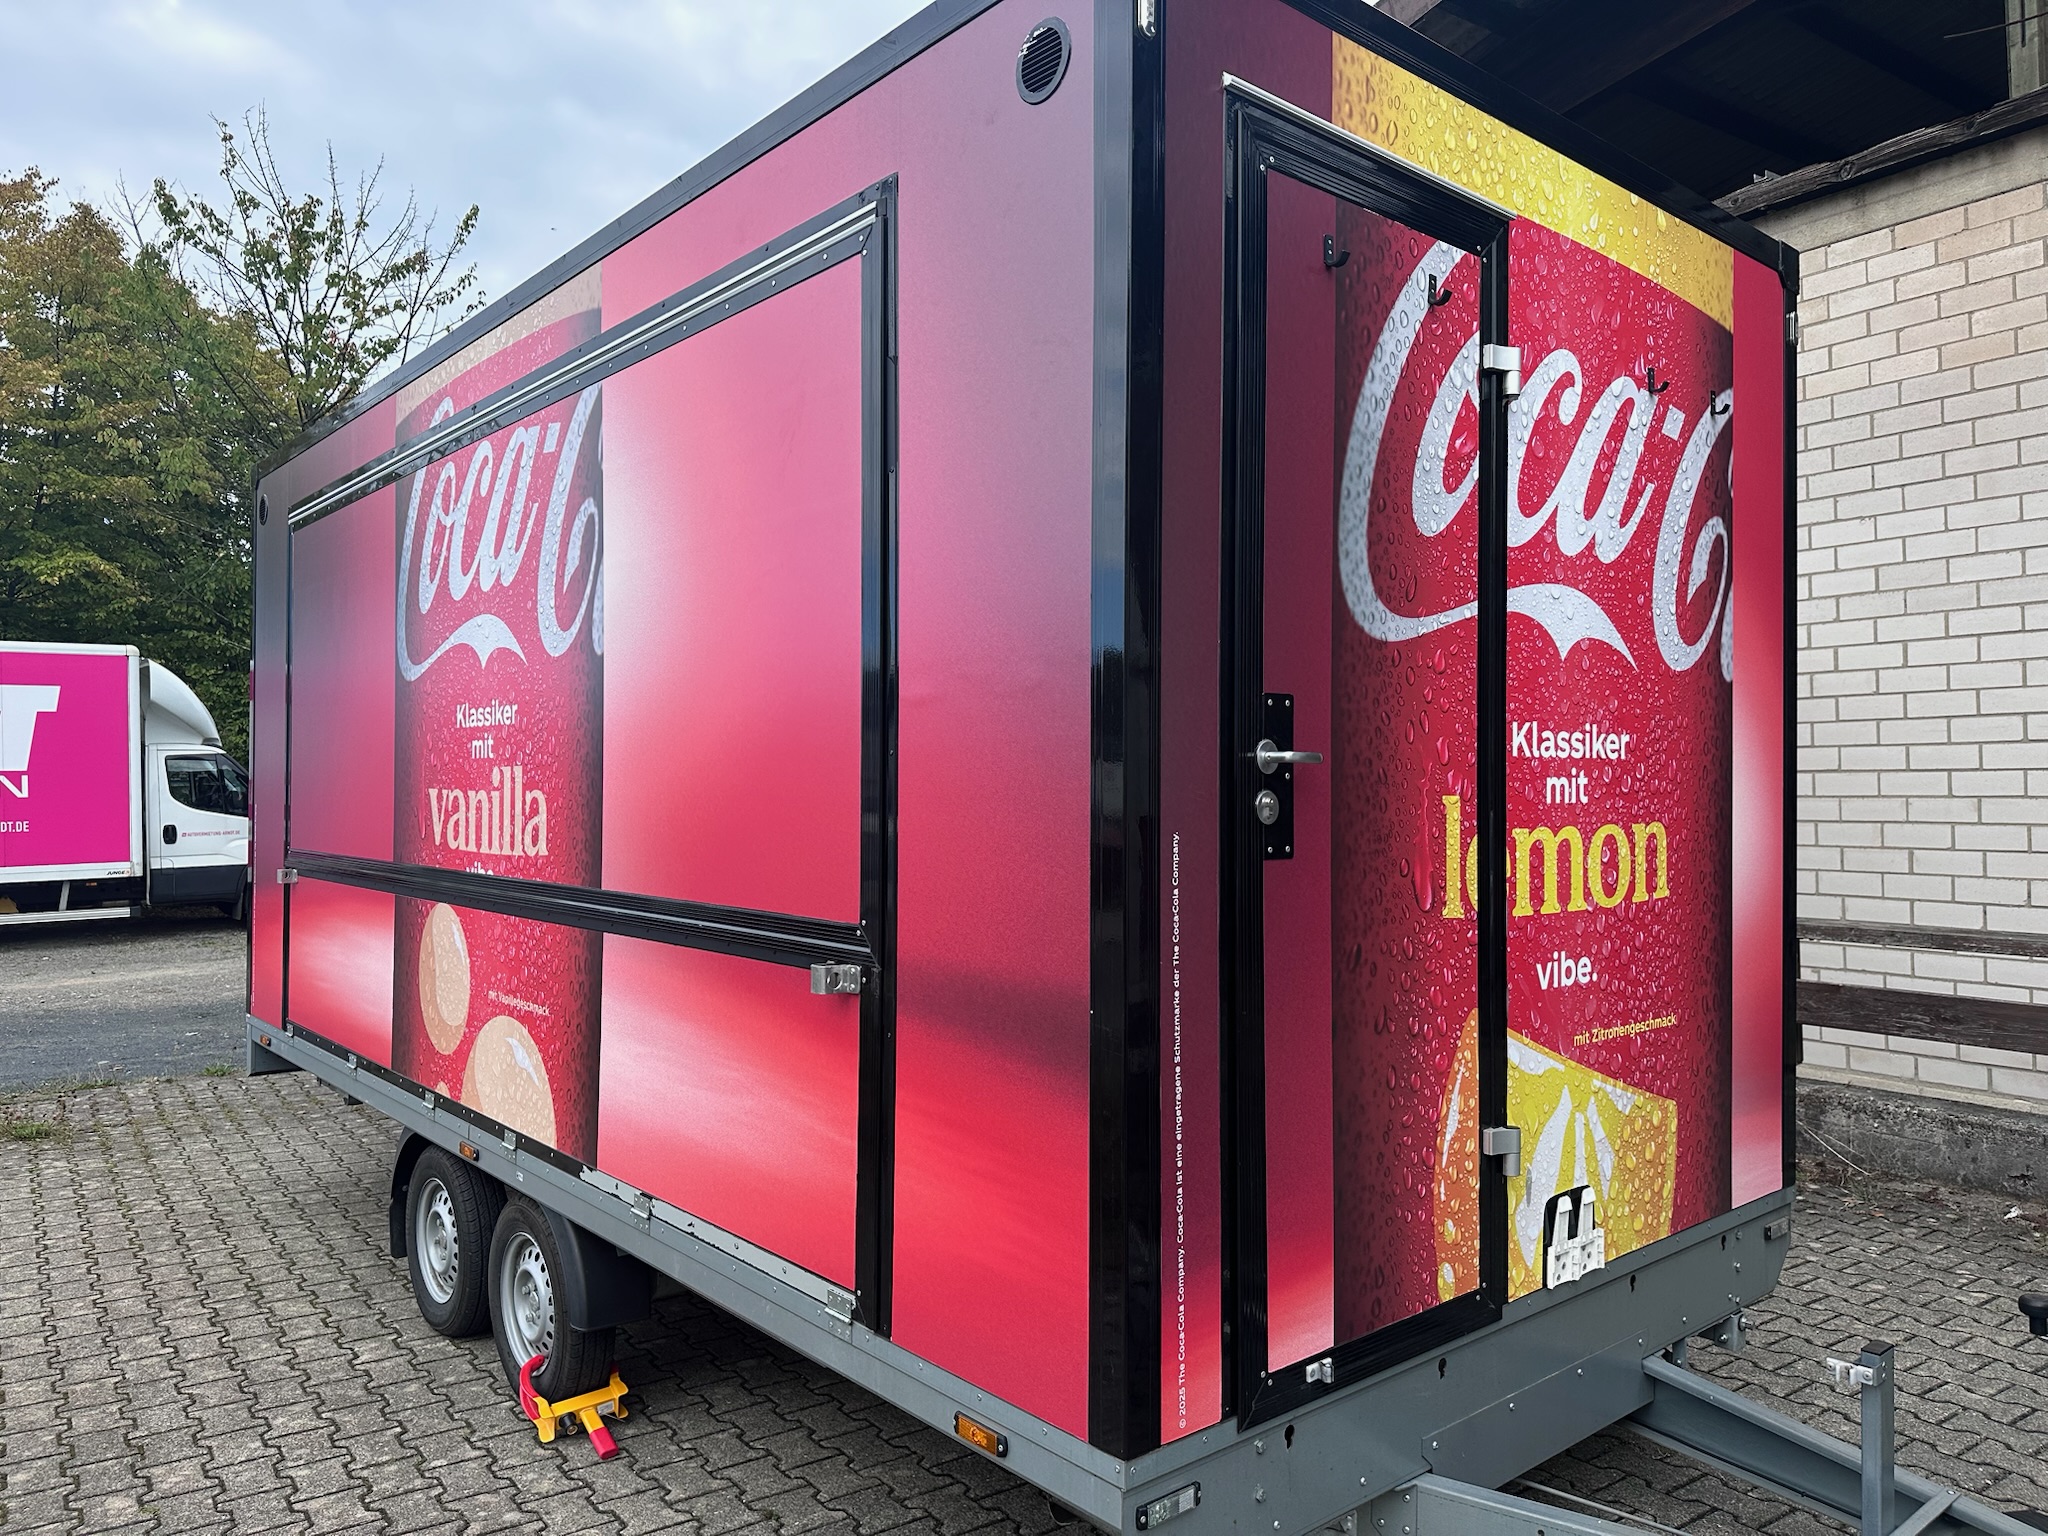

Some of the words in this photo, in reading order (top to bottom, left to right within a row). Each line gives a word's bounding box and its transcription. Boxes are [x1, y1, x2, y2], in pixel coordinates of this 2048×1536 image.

[1339, 240, 1734, 682] Coca-C
[396, 381, 604, 682] Coca-C
[456, 699, 518, 728] Klassiker
[471, 733, 494, 759] mit
[1512, 721, 1630, 760] Klassiker
[1546, 768, 1588, 804] mit
[0, 821, 30, 833] DT.DE
[428, 765, 549, 857] vanilla
[1172, 831, 1180, 886] Company.
[1172, 945, 1180, 967] The
[1536, 950, 1598, 990] vibe.
[1173, 990, 1181, 1064] Schutzmarke
[1573, 1030, 1590, 1047] mit
[1591, 1012, 1678, 1042] Zitronengeschmack
[1175, 1065, 1183, 1141] eingetragene
[1175, 1143, 1183, 1168] eine
[1175, 1169, 1183, 1185] ist
[1177, 1245, 1186, 1303] Company.
[1178, 1363, 1186, 1386] The
